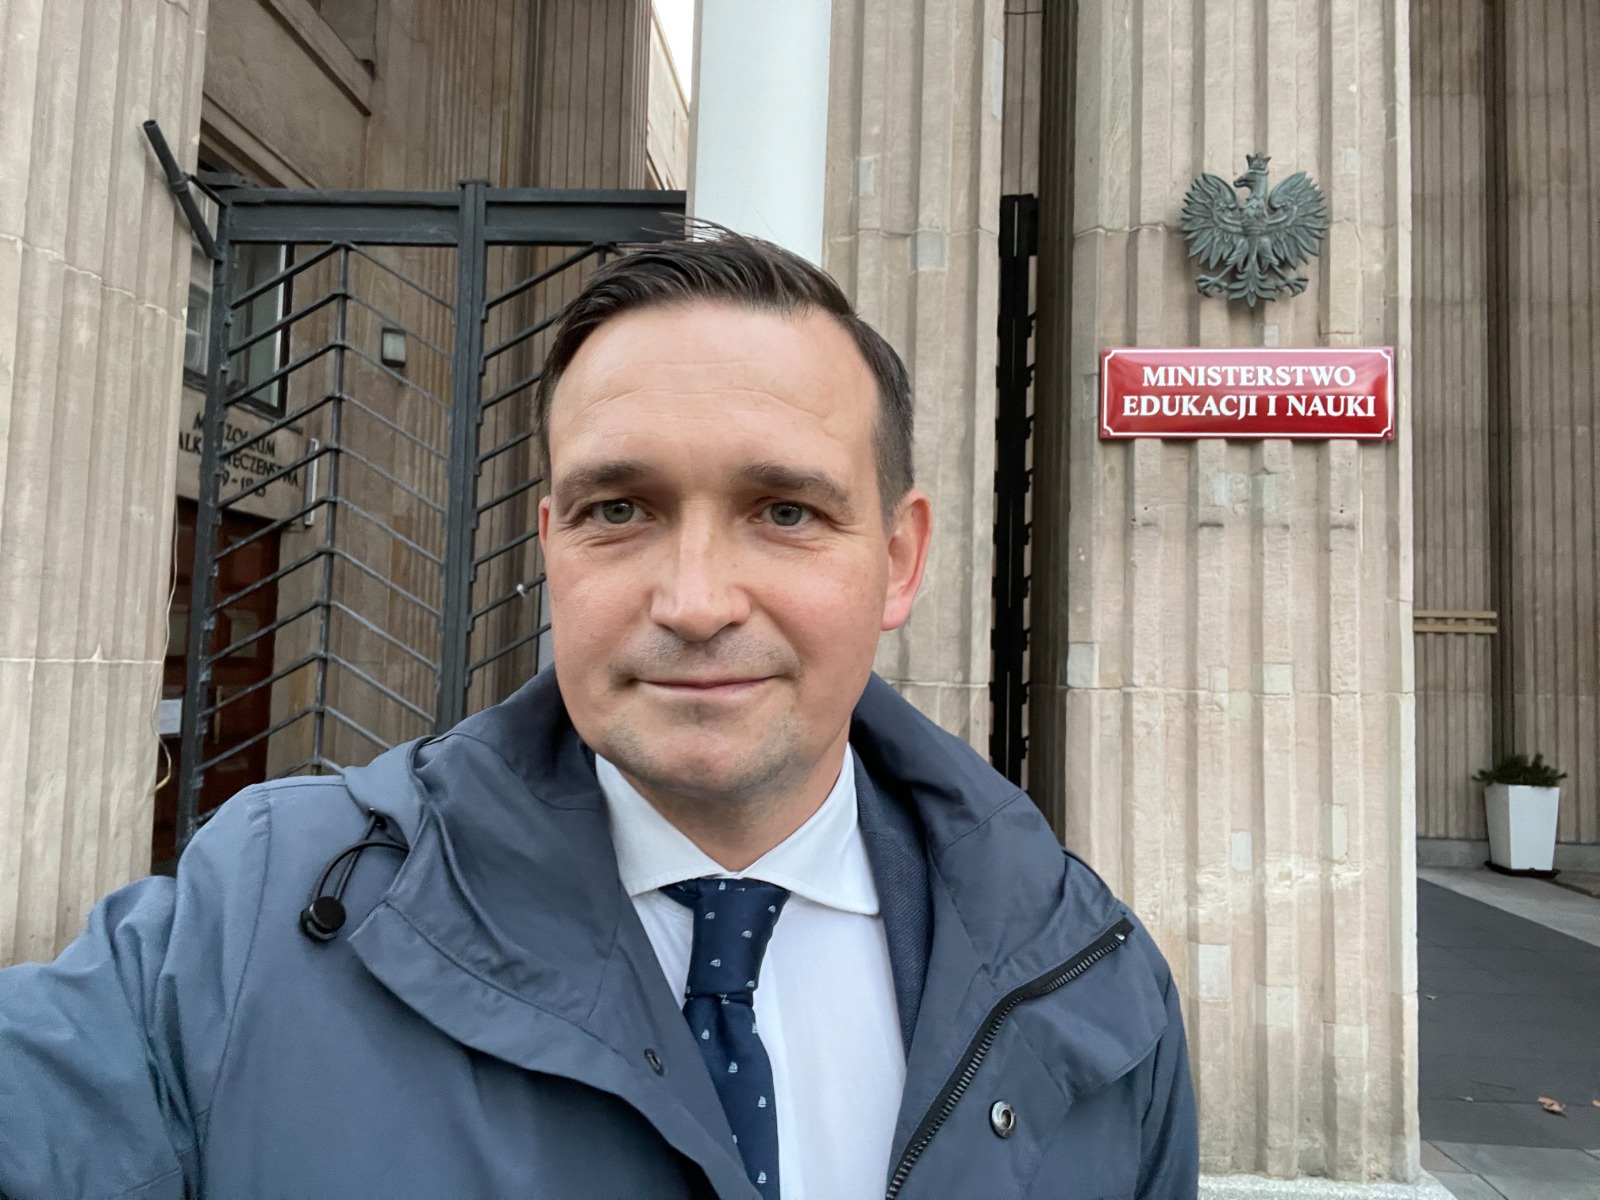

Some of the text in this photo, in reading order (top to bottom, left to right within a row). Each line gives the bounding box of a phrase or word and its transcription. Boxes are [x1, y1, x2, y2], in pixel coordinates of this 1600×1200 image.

[1142, 365, 1356, 387] MINISTERSTWO
[1122, 395, 1376, 420] EDUKACJI I NAUKI
